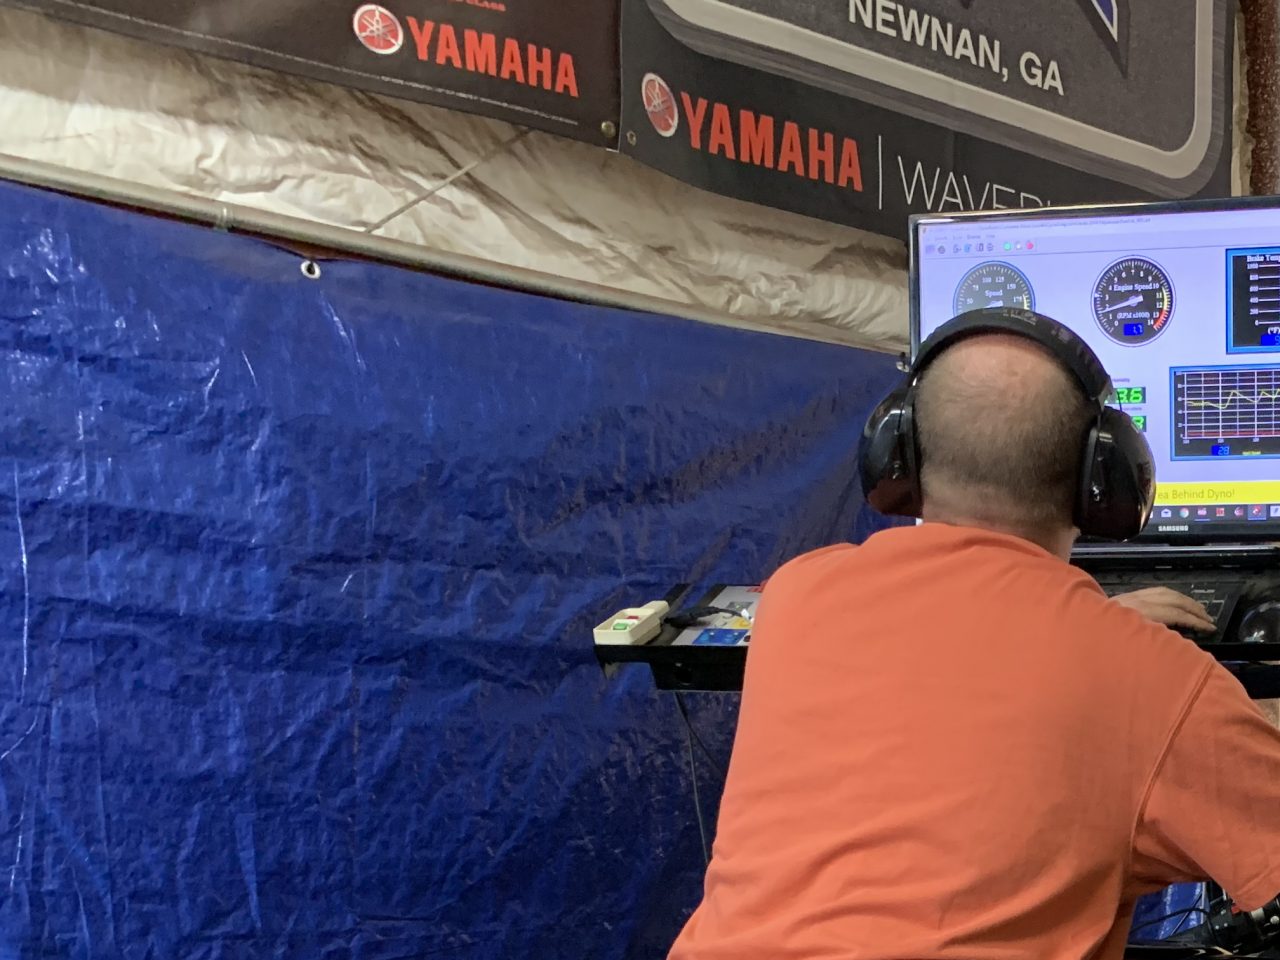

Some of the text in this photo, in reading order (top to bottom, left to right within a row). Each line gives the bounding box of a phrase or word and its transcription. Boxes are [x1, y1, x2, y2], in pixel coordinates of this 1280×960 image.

[406, 15, 579, 98] YAMAHA
[848, 0, 1064, 96] NEWNAN, GA
[680, 91, 863, 192] YAMAHA
[1113, 282, 1152, 292] Engine Speed
[1172, 489, 1204, 499] Behind
[1207, 488, 1235, 500] Dyno!
